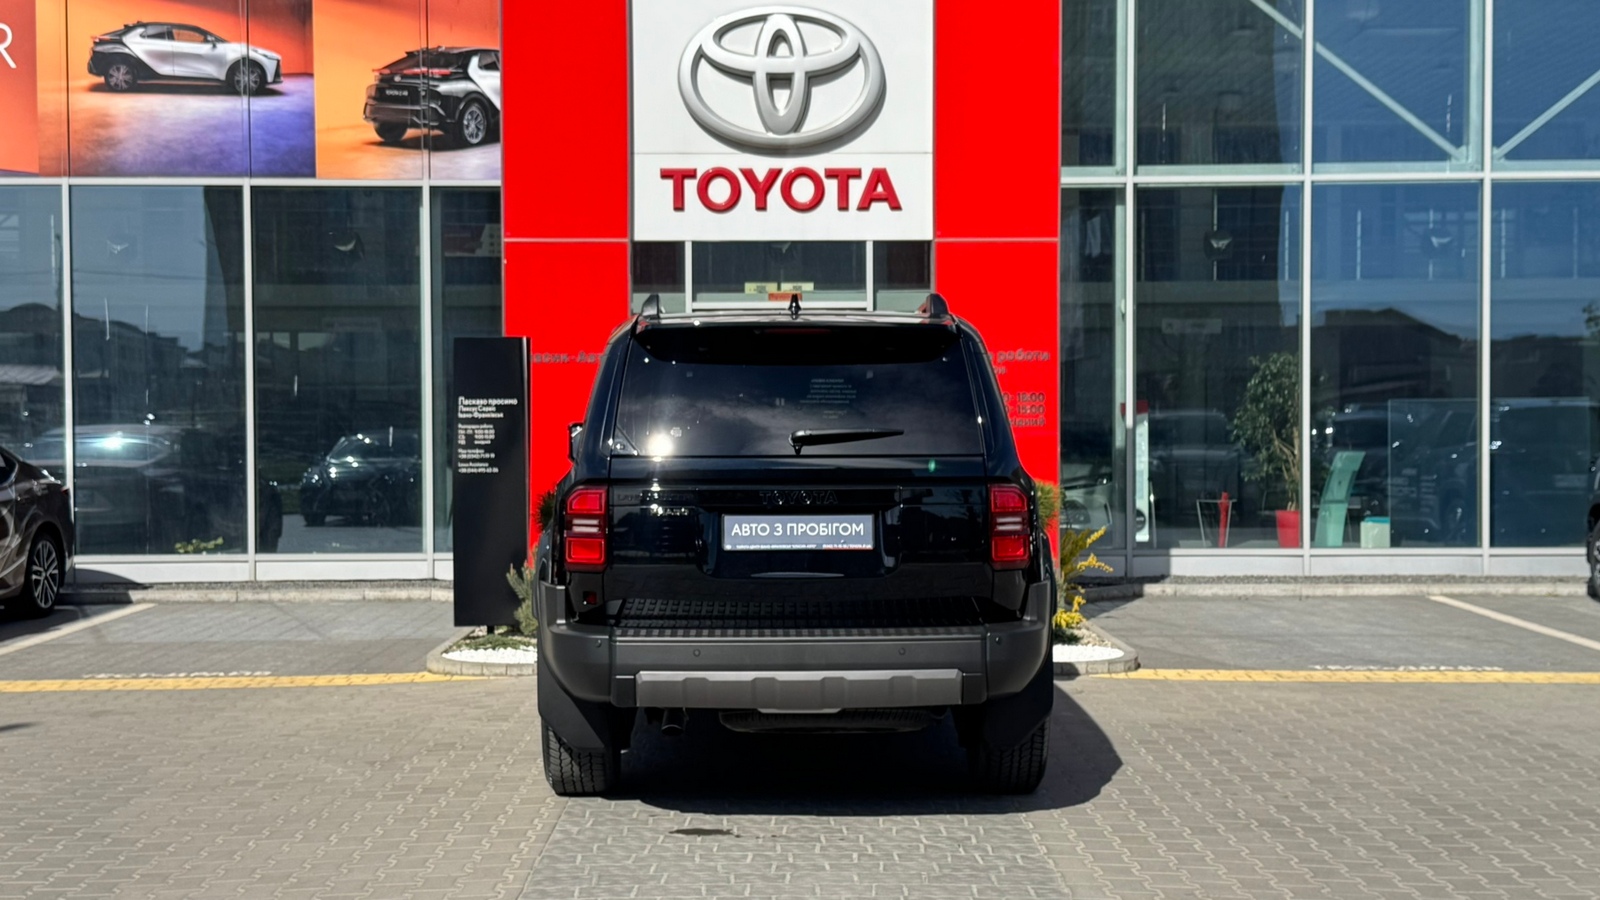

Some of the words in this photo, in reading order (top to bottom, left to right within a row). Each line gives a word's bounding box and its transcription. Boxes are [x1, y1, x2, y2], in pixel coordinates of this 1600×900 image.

[660, 166, 903, 213] TOYOTA
[998, 347, 1050, 364] роботи
[488, 398, 518, 407] просимо
[759, 490, 839, 504] TOYOTA
[731, 523, 770, 537] АВТО
[787, 523, 864, 536] ПРОБІГОМ
